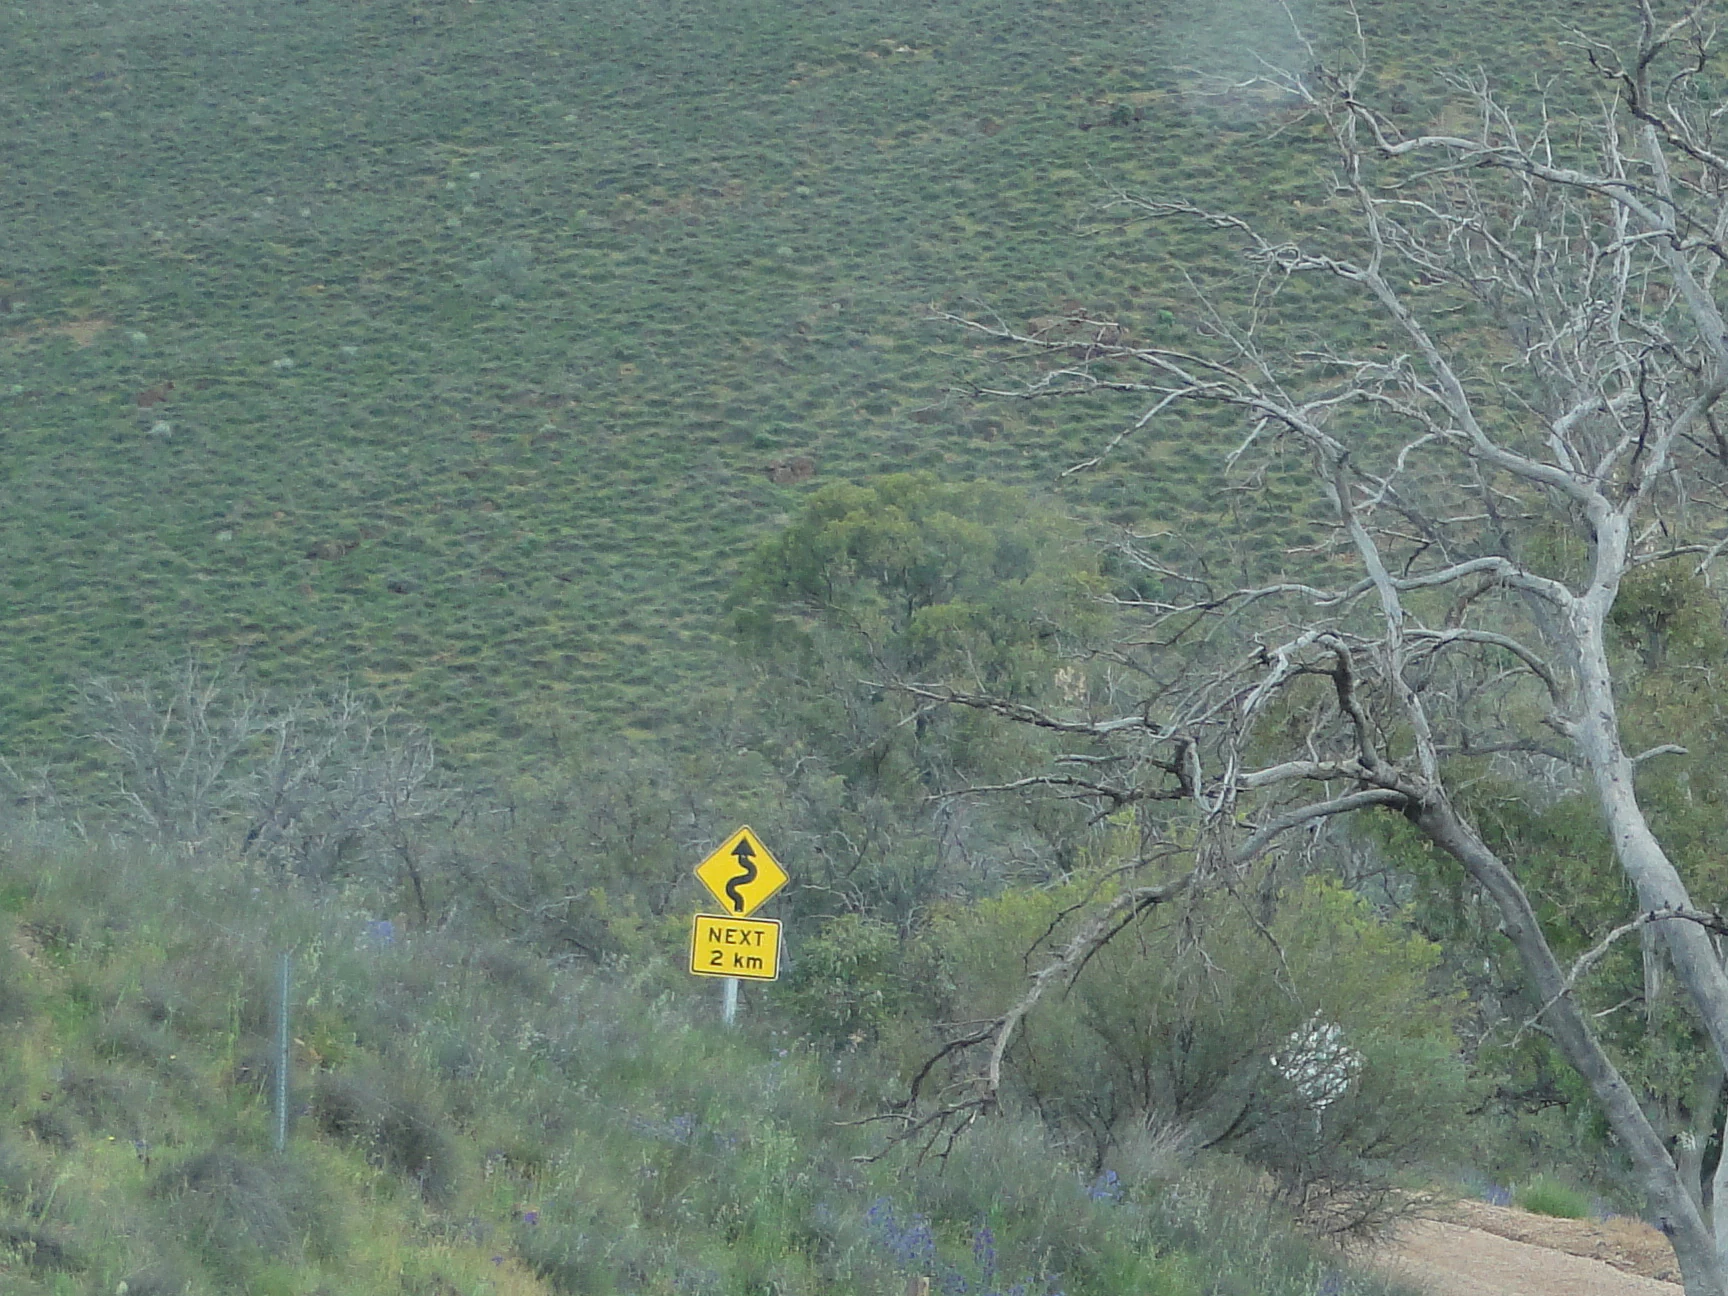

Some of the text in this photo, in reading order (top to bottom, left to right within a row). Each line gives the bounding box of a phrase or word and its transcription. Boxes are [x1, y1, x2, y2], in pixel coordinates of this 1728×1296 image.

[709, 927, 765, 946] NEXT
[710, 950, 763, 969] 2 km
